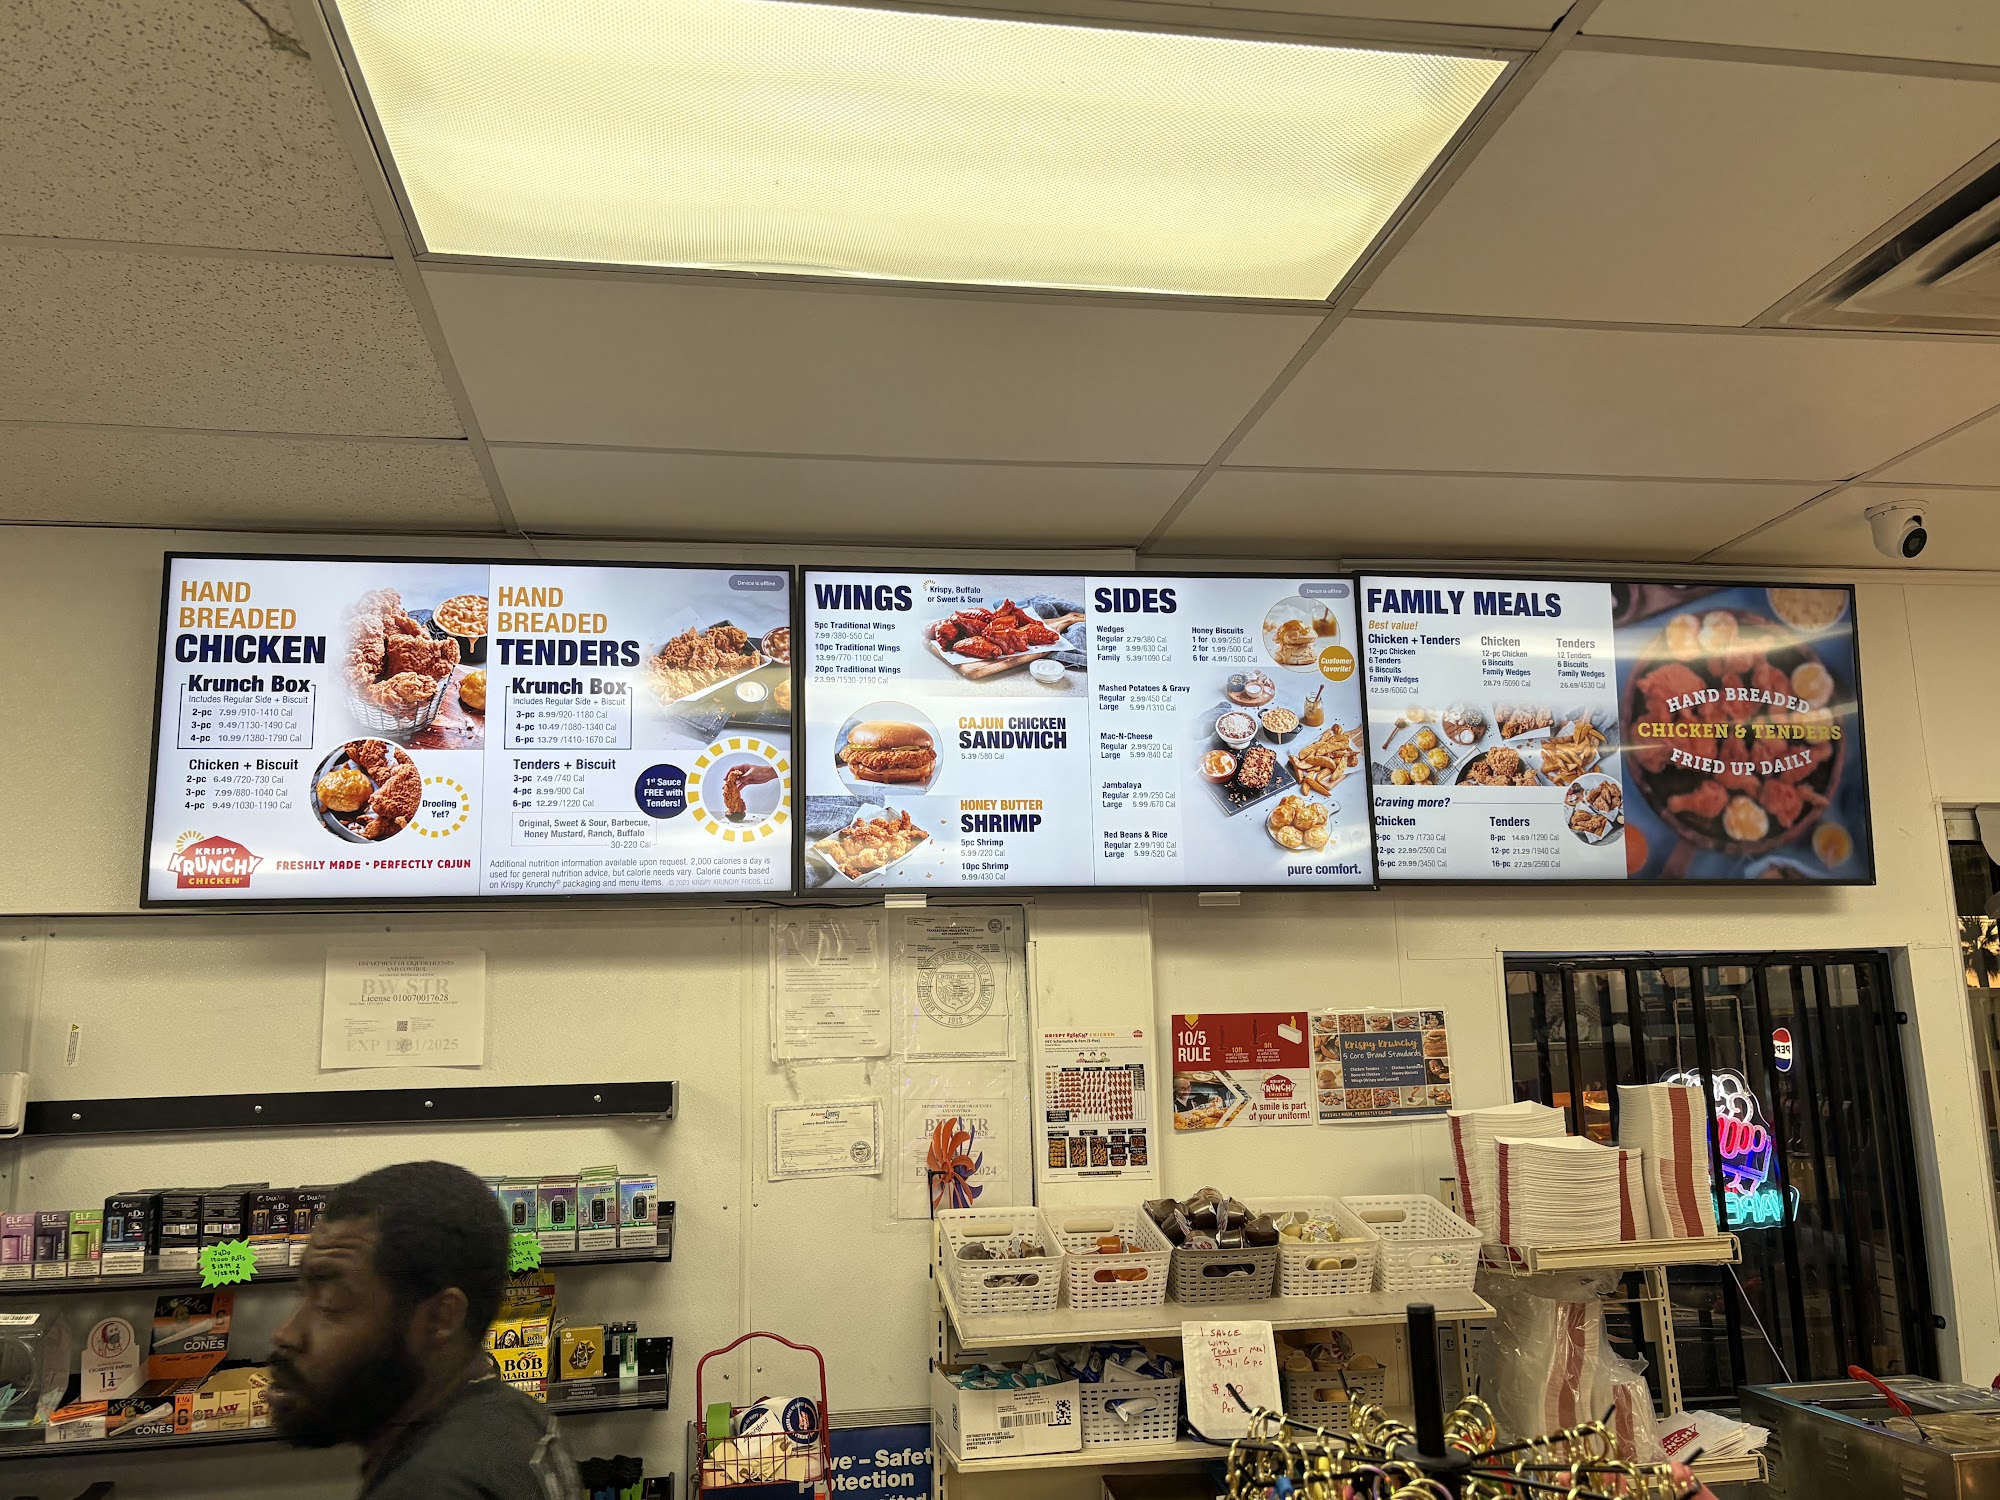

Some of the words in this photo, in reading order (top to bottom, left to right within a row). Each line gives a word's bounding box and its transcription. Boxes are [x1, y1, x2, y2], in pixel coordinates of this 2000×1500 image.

[181, 581, 251, 602] HAND
[930, 586, 954, 594] Krispy,
[956, 586, 980, 594] Buffalo
[498, 587, 563, 607] HAND
[815, 584, 912, 611] WINGS
[936, 595, 957, 603] Sweet
[1095, 588, 1176, 614] SIDES
[1367, 589, 1464, 614] FAMILY
[1474, 591, 1562, 617] MEALS
[179, 607, 296, 629] BREADED
[497, 612, 608, 633] BREADED
[815, 622, 828, 630] 5pc
[831, 621, 872, 629] Traditional
[873, 622, 895, 630] Wings
[1097, 625, 1124, 634] Wedges
[1369, 620, 1389, 629] Best
[1391, 620, 1418, 630] value!
[1192, 627, 1214, 635] Honey
[1368, 634, 1409, 644] Chicken
[1420, 635, 1461, 645] Tenders
[1481, 636, 1520, 647] Chicken
[1556, 638, 1595, 649] Tenders
[175, 634, 326, 663] CHICKEN
[496, 639, 640, 666] TENDERS
[1323, 665, 1351, 673] favorite!
[512, 678, 582, 694] Krunch
[590, 678, 627, 694] Box
[1099, 684, 1127, 692] Mashed
[1129, 684, 1161, 692] Potatoes
[1170, 685, 1190, 693] Gravy
[1666, 688, 1720, 713] HAND
[1725, 688, 1810, 714] BREADED
[959, 717, 1004, 729] CAJUN
[1008, 717, 1066, 730] CHICKEN
[1100, 732, 1153, 740] Mac-N-Cheese
[1637, 723, 1728, 738] CHICKEN
[1734, 723, 1746, 738] &
[1752, 723, 1842, 740] TENDERS
[959, 731, 1067, 749] SANDWICH
[513, 759, 560, 770] Tenders
[564, 761, 572, 769] +
[576, 759, 616, 770] Biscuit
[1670, 748, 1726, 774] FRIED
[1730, 761, 1756, 776] UP
[1759, 749, 1814, 775] DAILY
[657, 778, 681, 786] Sauce
[1102, 781, 1142, 790] Jambalaya
[185, 788, 206, 797] 3-pc
[644, 788, 663, 797] FREE
[665, 788, 683, 797] with
[422, 800, 457, 809] Drooling
[646, 799, 680, 808] Tenders!
[960, 800, 997, 810] HONEY
[1001, 800, 1043, 810] BUTTER
[1375, 797, 1414, 809] Craving
[1417, 797, 1451, 808] more?
[431, 810, 450, 818] Yet?
[961, 814, 1042, 833] SHRIMP
[1375, 815, 1416, 826] Chicken
[1489, 817, 1530, 827] Tenders
[639, 840, 651, 848] Cal
[195, 847, 237, 856] KRISPY
[168, 853, 263, 876] KRUNCHY
[276, 861, 325, 870] FRESHLY
[329, 860, 361, 869] MADE
[373, 859, 433, 869] PERFECTLY
[437, 859, 471, 869] CAJUN
[489, 860, 526, 868] Additional
[562, 859, 602, 867] information
[605, 858, 637, 867] available
[640, 860, 657, 868] upon
[659, 858, 688, 868] request.
[690, 858, 712, 866] 2,000
[750, 857, 763, 866] day
[1287, 865, 1312, 876] pure
[1315, 863, 1361, 874] comfort.
[188, 877, 241, 885] CHICKEN
[362, 979, 397, 995] BW
[406, 979, 450, 994] STR
[362, 994, 391, 1002] License
[393, 994, 448, 1002] 010070017628
[1178, 1031, 1206, 1046] 10/5
[347, 1040, 380, 1051] EXP
[1344, 1040, 1376, 1051] Krispy
[1378, 1039, 1418, 1049] Krunchy
[1178, 1047, 1211, 1062] RULE
[1388, 1050, 1422, 1058] Standards
[1260, 1083, 1296, 1094] KRUNCHY
[1259, 1102, 1280, 1111] smile
[1283, 1102, 1289, 1110] is
[1291, 1102, 1307, 1112] part
[1249, 1113, 1256, 1121] of
[1258, 1113, 1274, 1122] your
[1276, 1111, 1310, 1120] uniform!
[184, 1340, 225, 1350] CONES
[1212, 1347, 1243, 1355] Tender
[1250, 1344, 1266, 1354] Meal
[504, 1358, 542, 1371] BOB
[1244, 1357, 1250, 1365] 6
[503, 1370, 544, 1380] MARLEY
[204, 1403, 239, 1422] RAW
[1222, 1402, 1235, 1413] Per
[177, 1409, 188, 1426] 6
[135, 1425, 173, 1435] CONES
